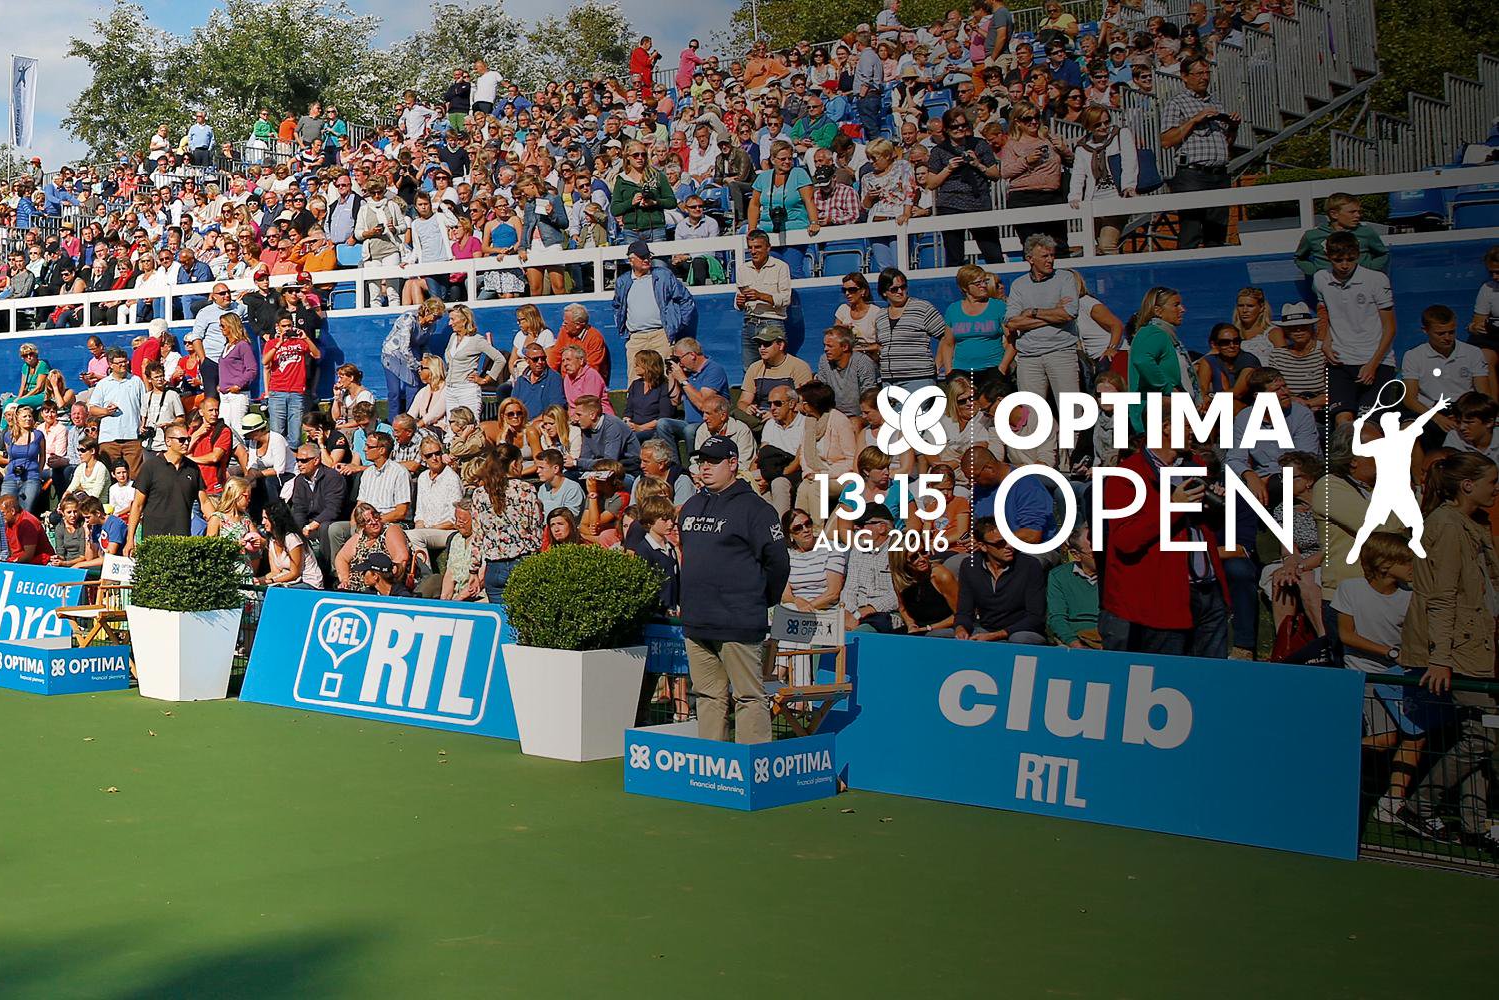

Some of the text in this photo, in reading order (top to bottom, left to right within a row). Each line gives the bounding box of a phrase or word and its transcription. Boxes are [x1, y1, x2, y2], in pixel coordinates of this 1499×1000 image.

[16, 580, 72, 599] BELGIQUE
[326, 616, 361, 646] BEL
[4, 654, 45, 675] OPTIMA
[68, 656, 126, 675] OPTIMA
[359, 612, 474, 715] RTL
[938, 655, 1193, 749] club
[655, 749, 744, 782] OPTIMA
[773, 750, 832, 778] OPTIMA
[689, 779, 745, 795] financial planning
[1015, 752, 1086, 808] RTL
